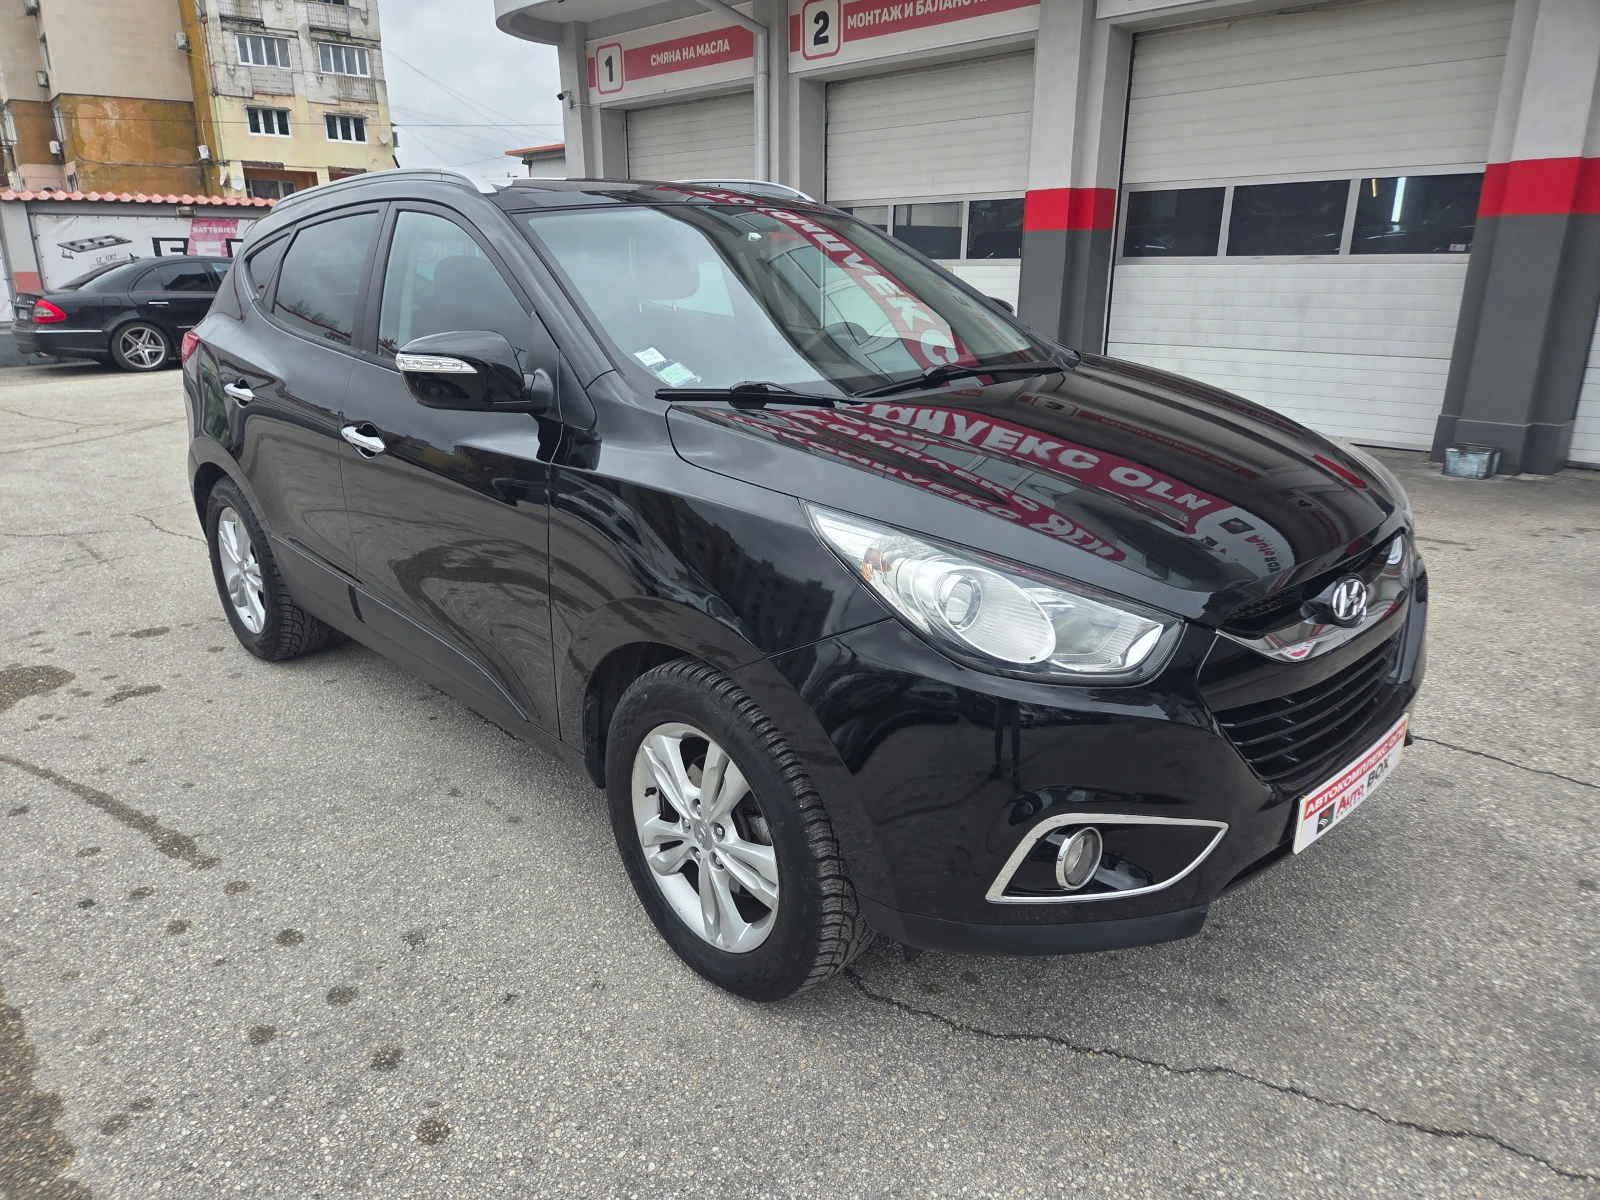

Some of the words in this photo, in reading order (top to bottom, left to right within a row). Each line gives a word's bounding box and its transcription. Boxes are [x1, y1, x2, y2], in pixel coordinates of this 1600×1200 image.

[813, 10, 830, 46] 2
[846, 4, 902, 30] МОНТАЖ
[904, 2, 914, 19] И
[650, 49, 682, 67] СМЯНА
[682, 46, 696, 60] НА
[696, 38, 731, 56] МАСЛА
[604, 54, 614, 83] 1
[192, 226, 237, 234] BATTERIES
[1367, 756, 1390, 787] BOX
